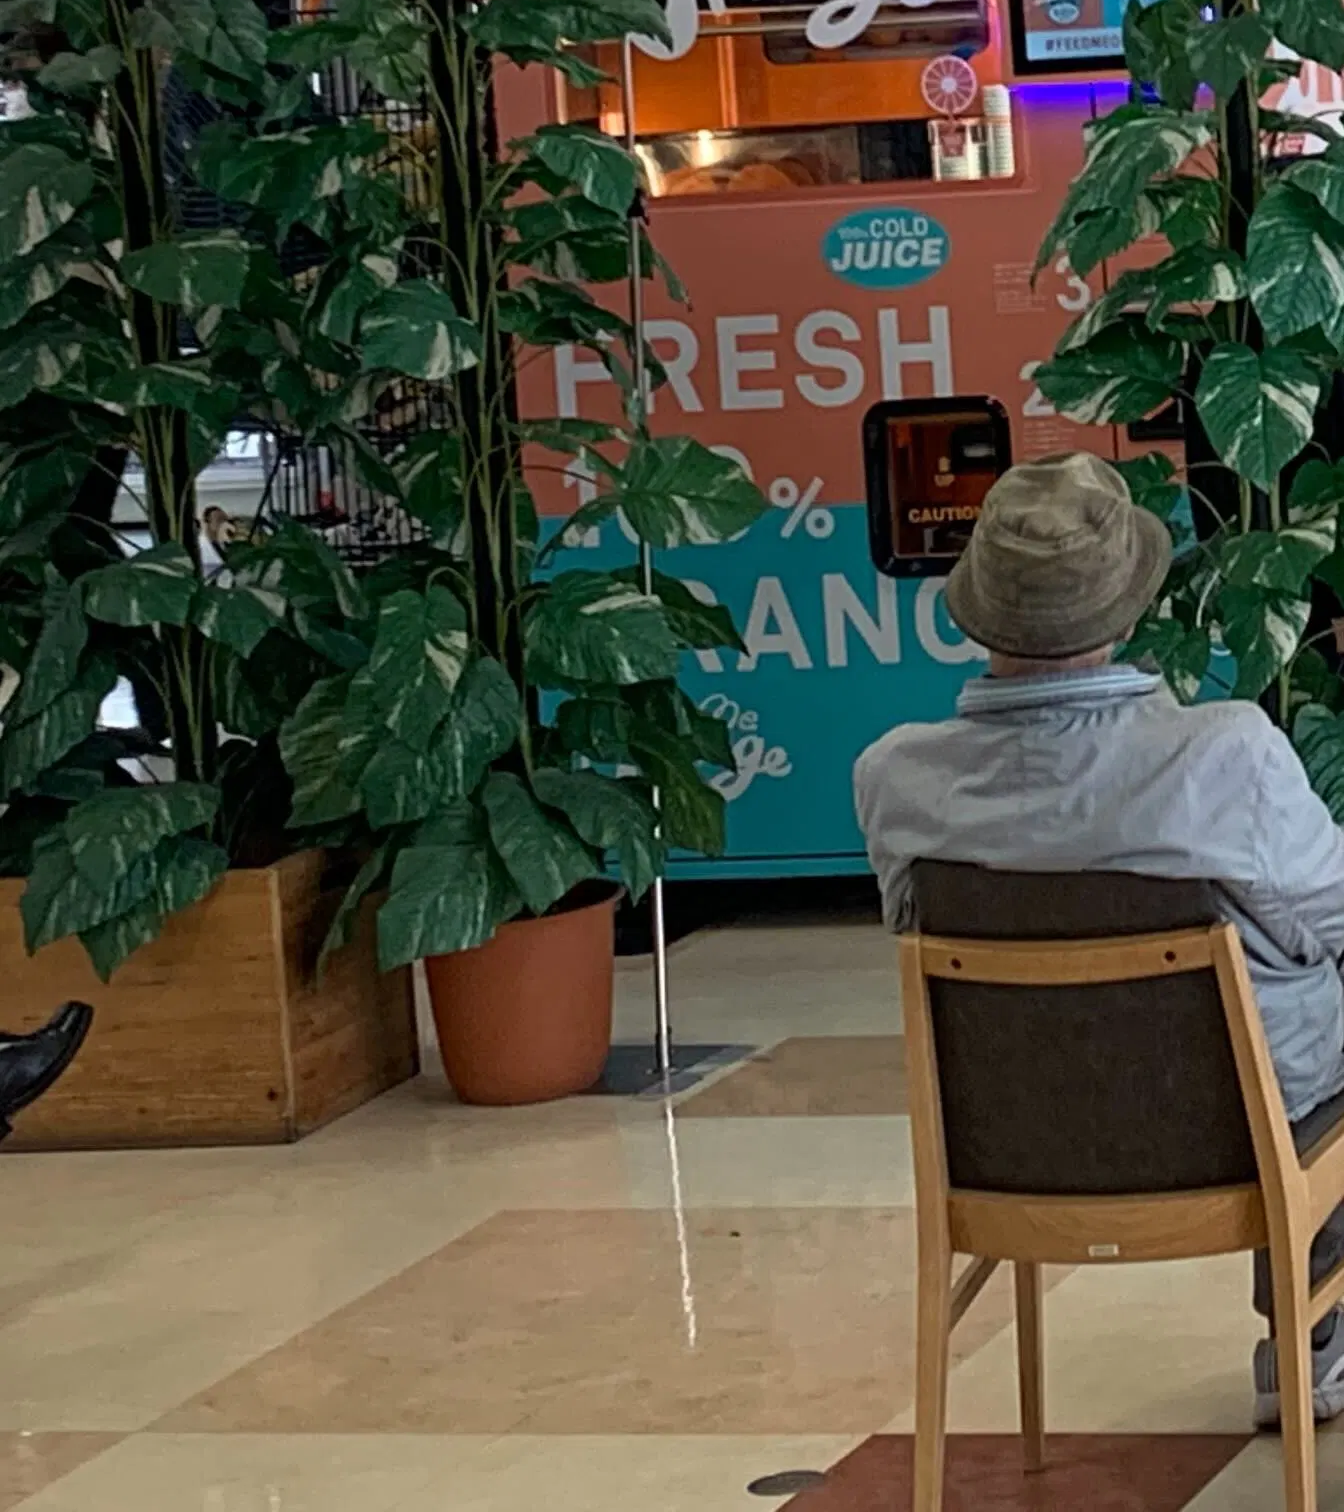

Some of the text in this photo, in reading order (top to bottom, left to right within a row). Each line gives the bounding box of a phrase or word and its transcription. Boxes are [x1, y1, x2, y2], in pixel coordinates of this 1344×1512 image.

[869, 216, 929, 238] COLD
[831, 238, 944, 272] JUICE
[554, 305, 955, 420] FRESH
